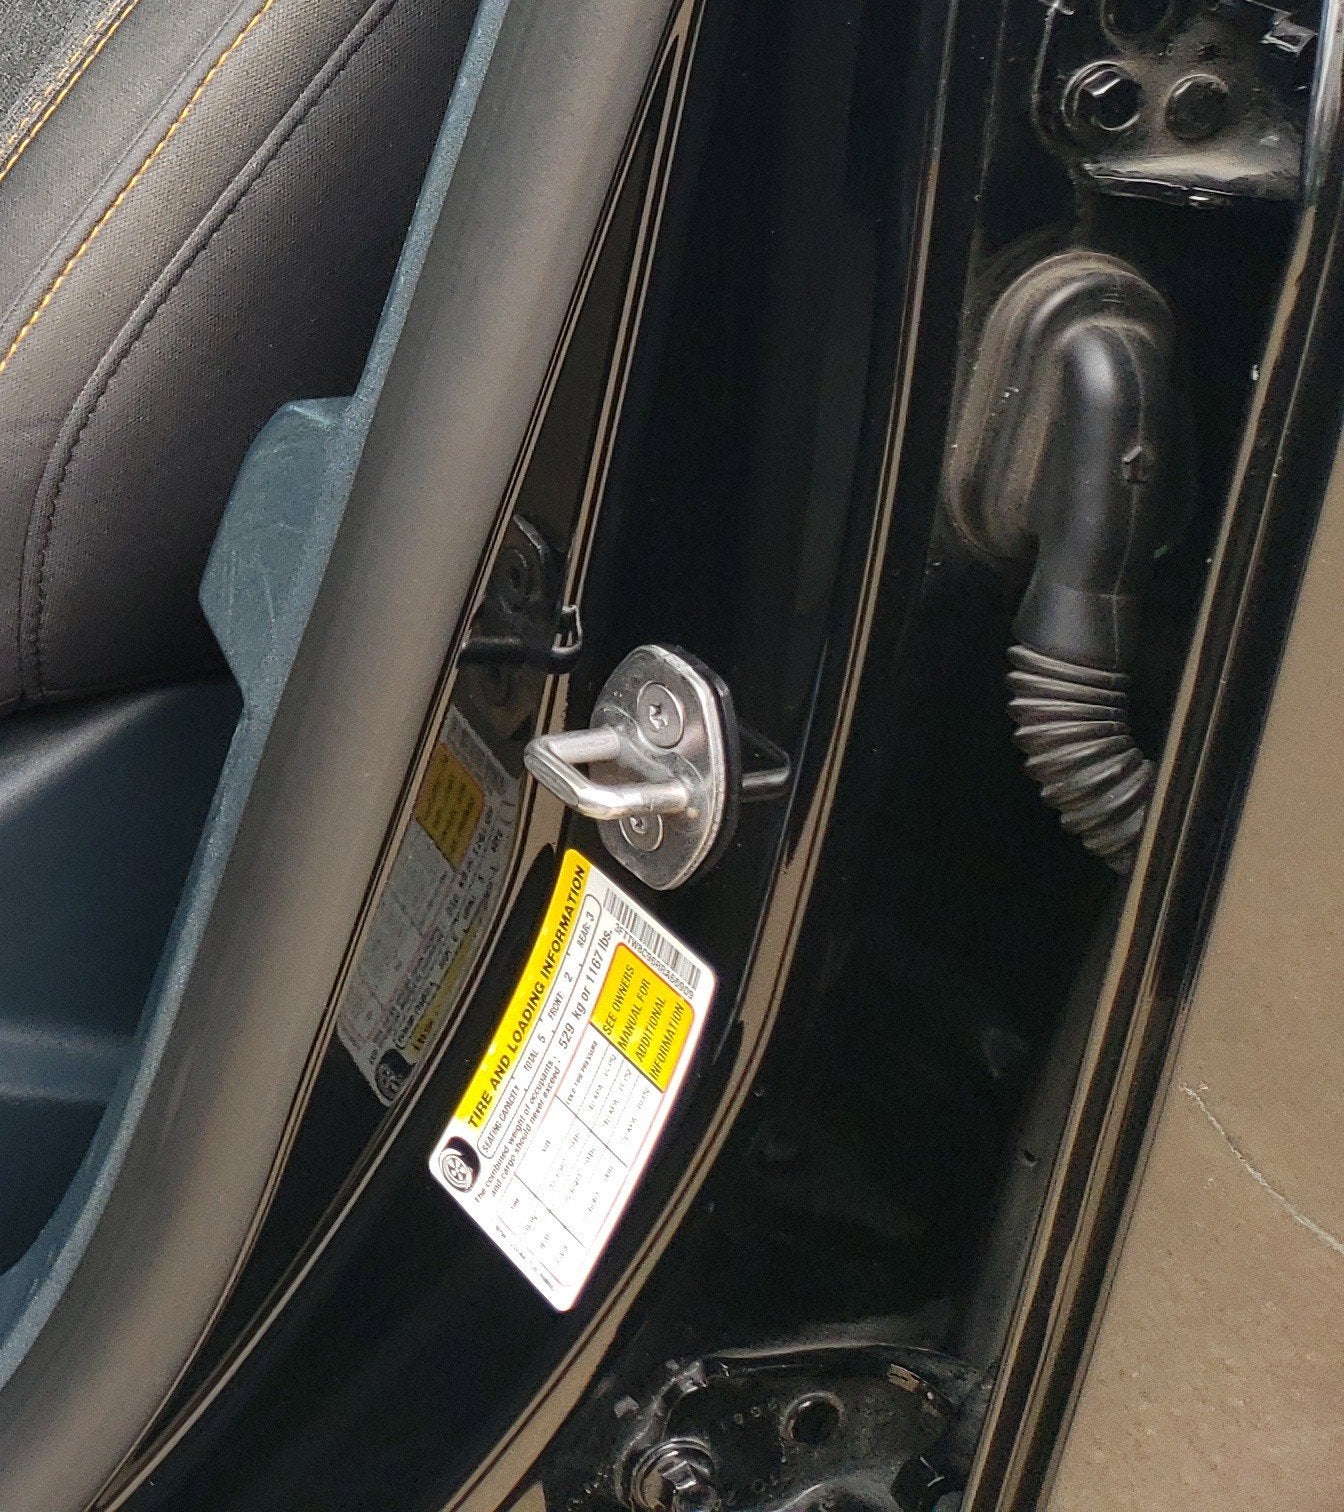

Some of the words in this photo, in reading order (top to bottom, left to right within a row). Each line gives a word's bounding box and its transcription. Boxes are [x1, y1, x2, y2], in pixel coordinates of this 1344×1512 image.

[585, 949, 604, 983] 1167
[598, 930, 612, 950] lbs.
[467, 1090, 492, 1126] TIRE
[491, 1053, 510, 1090] AND
[506, 980, 545, 1053] LOADING
[540, 864, 585, 979] INFORMATION
[572, 1002, 586, 1019] kg
[581, 985, 590, 1001] or
[602, 1012, 617, 1035] SEE
[610, 964, 635, 1011] OWNERS
[617, 1003, 642, 1050] MANUAL
[636, 977, 651, 1002] FOR
[634, 995, 666, 1062] ADDITIONAL
[481, 1120, 502, 1152] SEATING
[499, 1084, 520, 1121] CAPACITY
[536, 1033, 546, 1043] 5
[563, 971, 573, 981] 2
[576, 922, 590, 947] REAR:
[585, 911, 594, 921] 3
[558, 1022, 575, 1048] 529
[648, 1002, 684, 1080] INFORMATION
[474, 1188, 487, 1203] The
[484, 1146, 510, 1187] combined
[508, 1116, 525, 1145] weight
[523, 1104, 530, 1115] of
[529, 1059, 553, 1104] occupants
[491, 1180, 502, 1196] and
[500, 1154, 516, 1179] cargo
[513, 1123, 532, 1154] should
[529, 1099, 544, 1124] never
